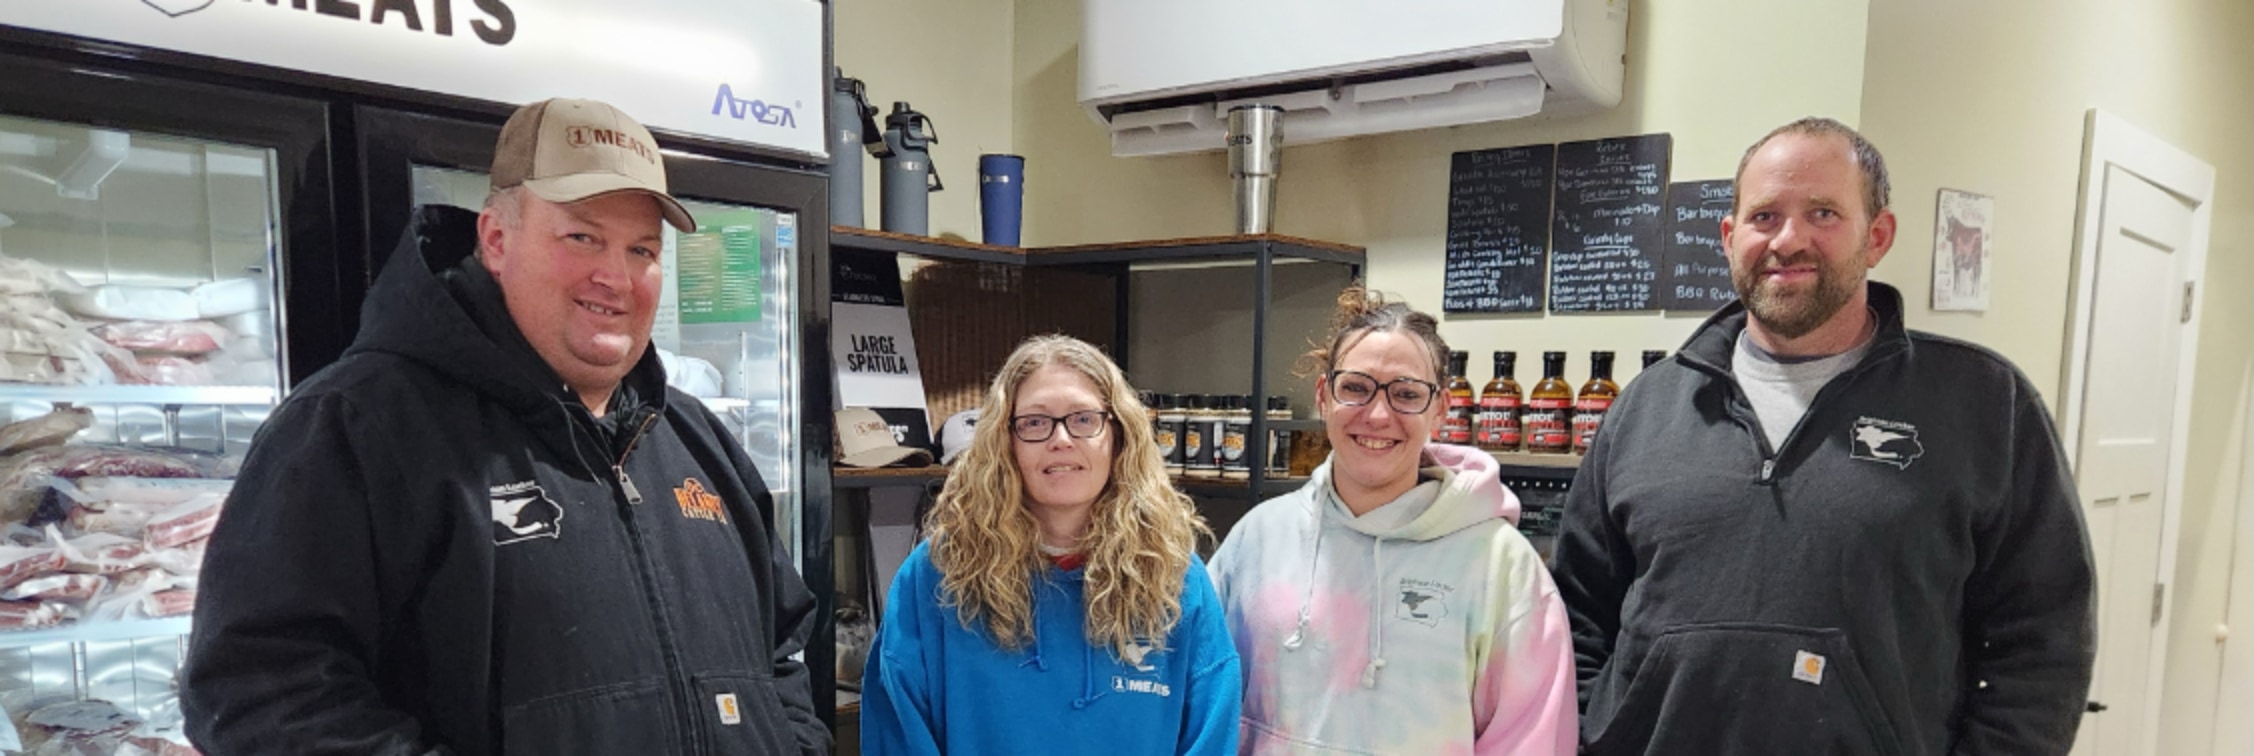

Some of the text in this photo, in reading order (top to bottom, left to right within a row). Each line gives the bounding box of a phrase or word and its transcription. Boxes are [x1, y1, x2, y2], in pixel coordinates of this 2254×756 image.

[593, 129, 655, 165] MEATS
[1675, 285, 1705, 299] BBQ
[851, 334, 897, 355] LARGE
[847, 353, 909, 375] SPATULA
[1129, 680, 1171, 697] MEATS
